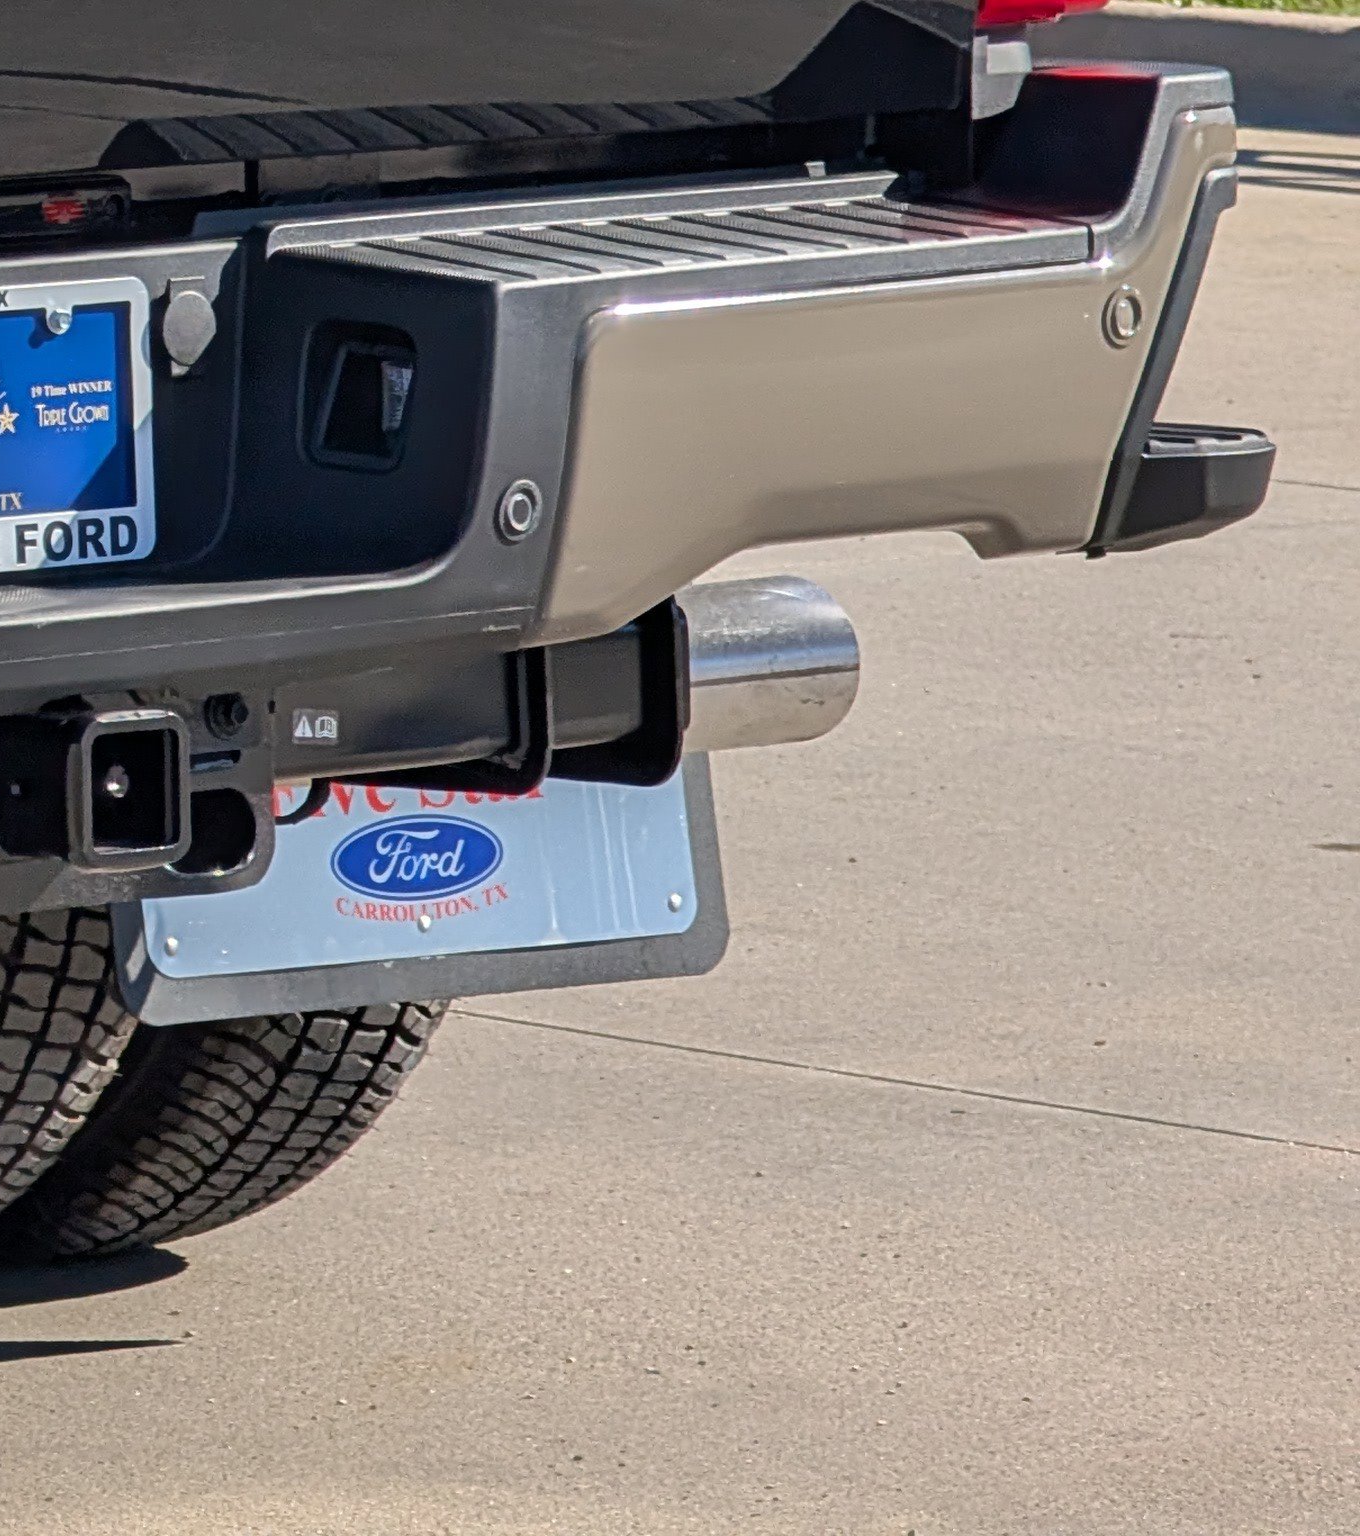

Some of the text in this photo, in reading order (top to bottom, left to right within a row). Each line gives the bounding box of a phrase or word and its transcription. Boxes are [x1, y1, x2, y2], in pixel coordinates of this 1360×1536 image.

[68, 380, 112, 394] WINNER
[15, 515, 139, 564] FORD
[368, 829, 466, 884] Ford
[482, 883, 509, 907] TX
